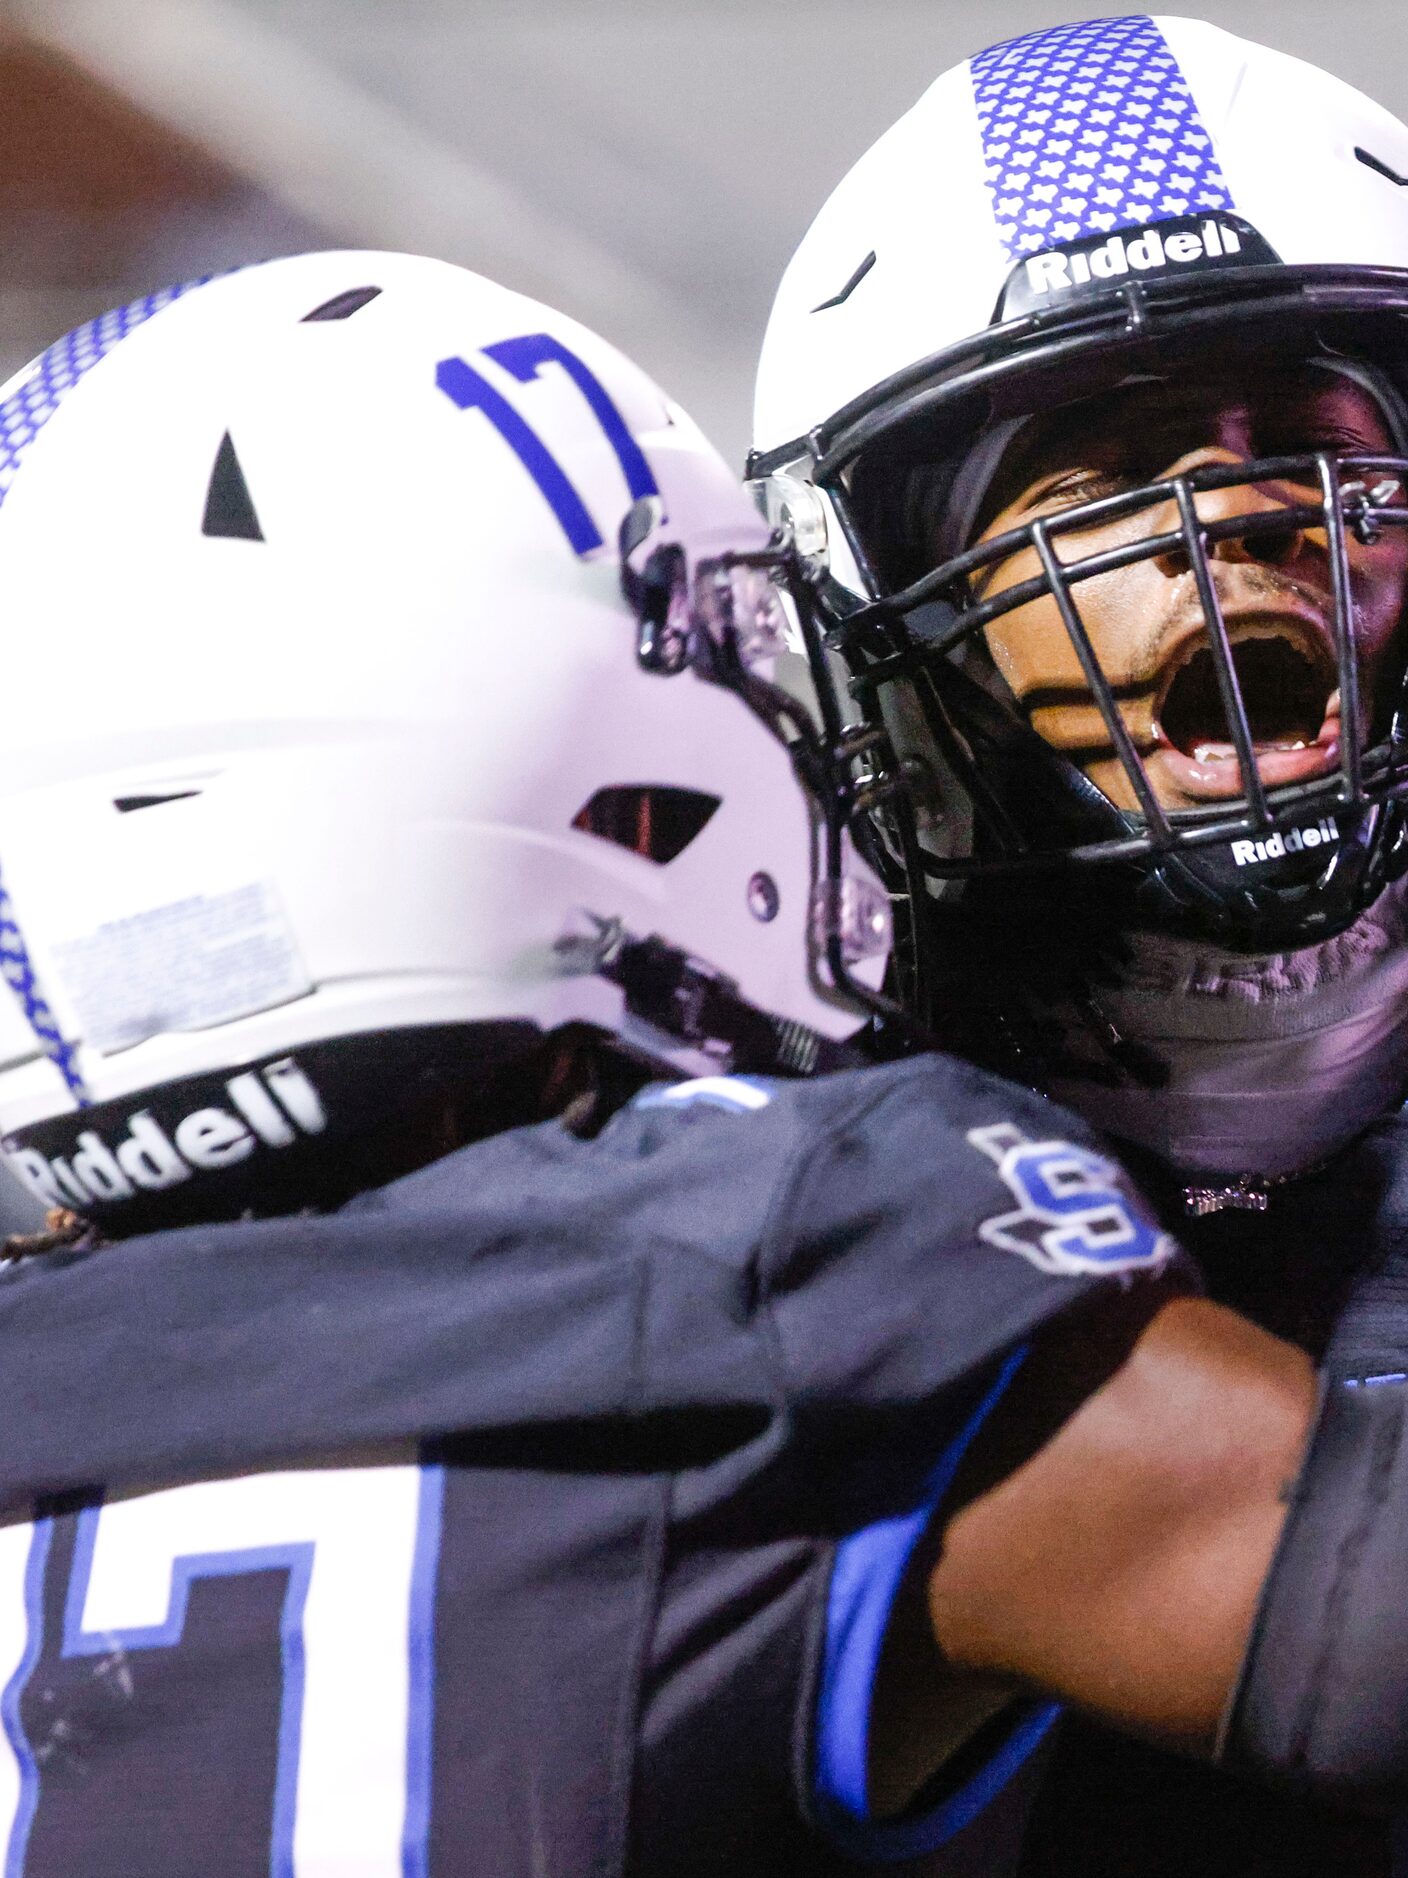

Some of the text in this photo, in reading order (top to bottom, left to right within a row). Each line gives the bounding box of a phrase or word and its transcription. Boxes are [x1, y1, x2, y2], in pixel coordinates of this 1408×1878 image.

[1025, 219, 1241, 294] Riddell
[434, 332, 661, 556] 17
[1231, 815, 1340, 866] Riddell
[2, 1056, 327, 1207] Riddell
